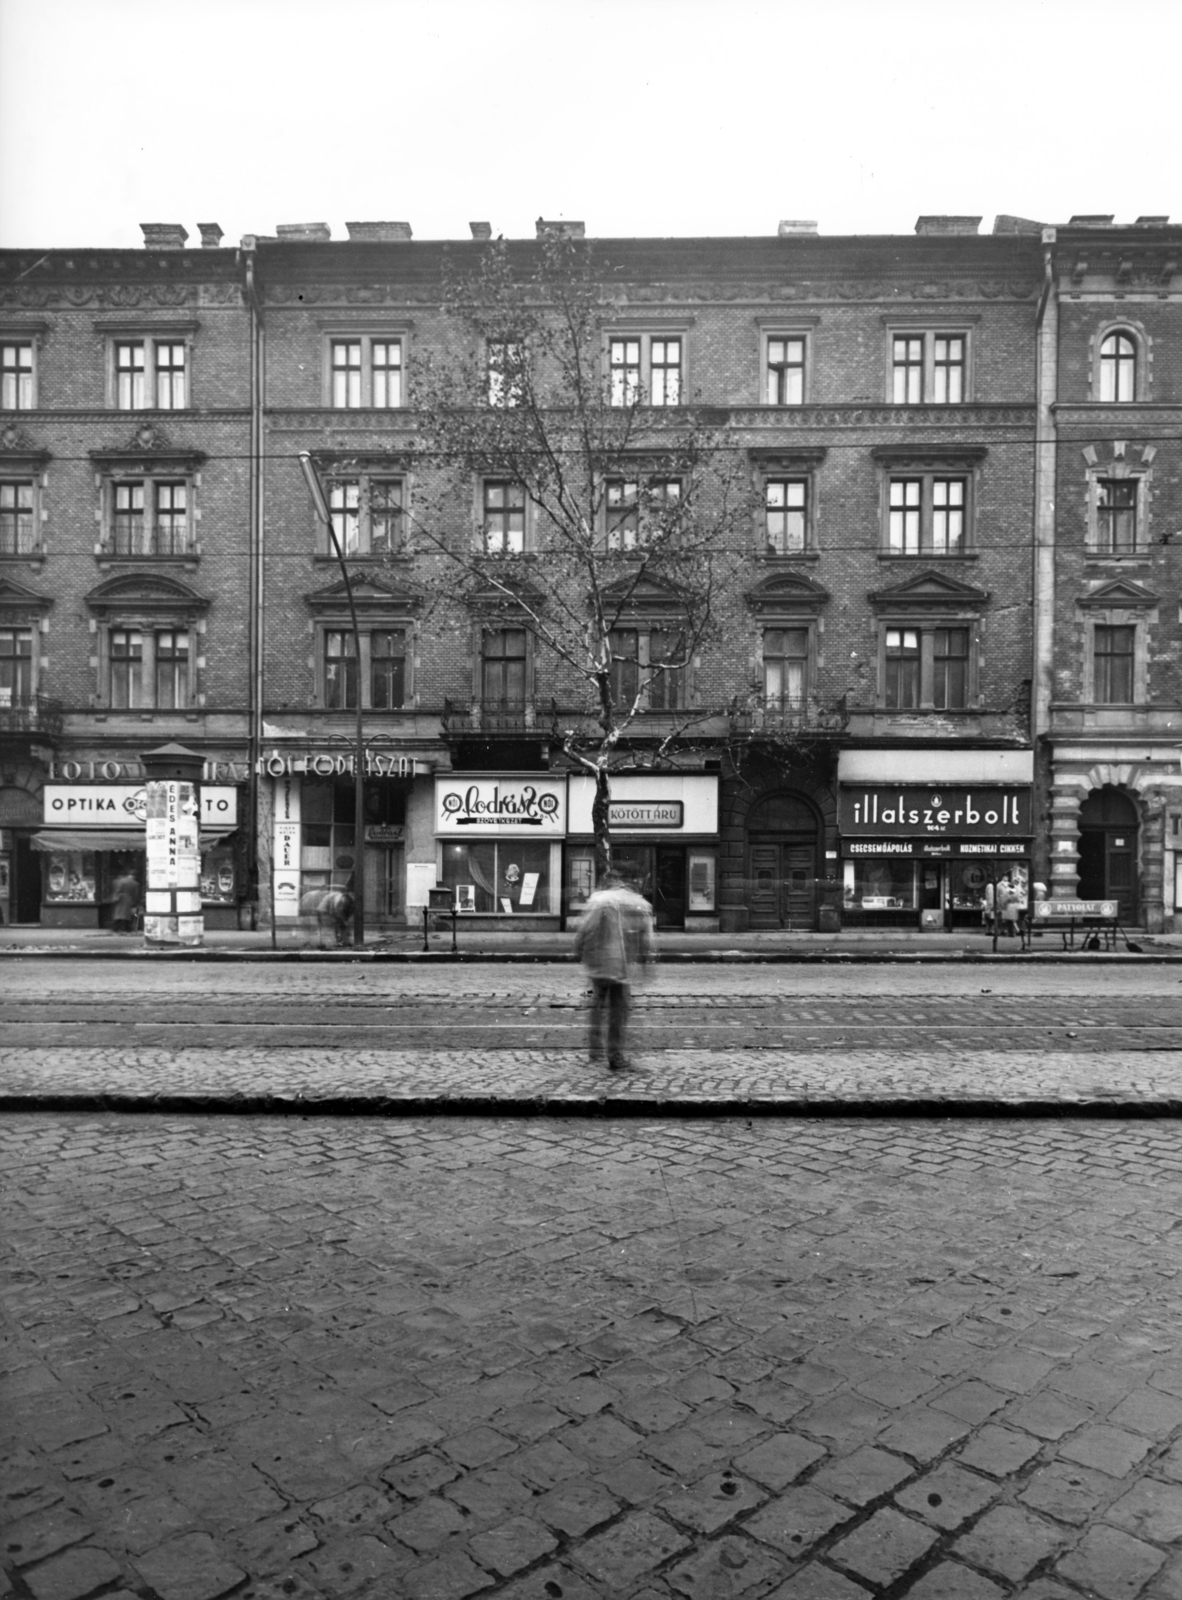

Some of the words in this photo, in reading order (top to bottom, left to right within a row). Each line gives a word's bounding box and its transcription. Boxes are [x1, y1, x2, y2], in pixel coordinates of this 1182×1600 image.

[52, 799, 116, 811] OPTIKA
[206, 800, 229, 811] TO
[854, 794, 1019, 824] illatszerbolt
[611, 807, 651, 819] KÖTÖTT
[654, 804, 676, 819] ÁRU
[850, 842, 913, 853] CSECSEMŐÁPOLÁS
[960, 844, 997, 853] KOZMETIKAI
[1000, 844, 1025, 853] CIKKEK
[1057, 903, 1096, 911] PATYOLAT
